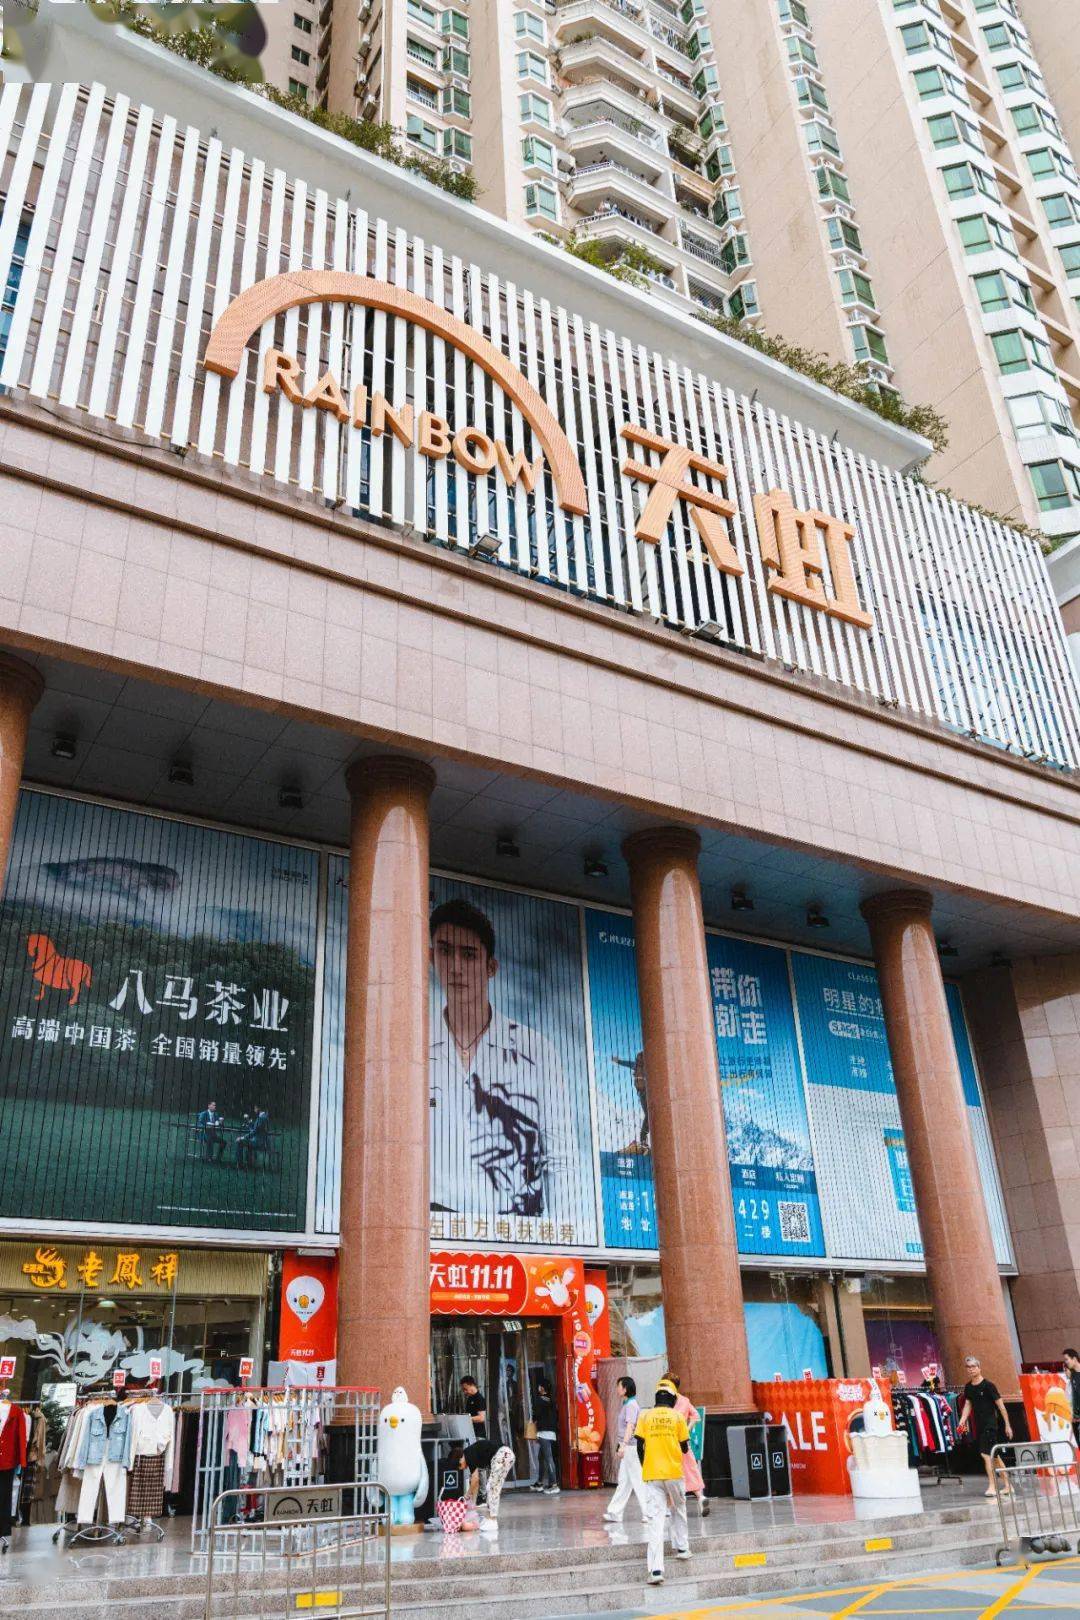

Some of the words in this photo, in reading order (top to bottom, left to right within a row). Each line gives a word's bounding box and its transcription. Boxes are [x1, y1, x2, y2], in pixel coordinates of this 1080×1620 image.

[263, 347, 545, 494] RAINBOW
[620, 421, 873, 628] 天虹
[109, 969, 290, 1032] 八马茶业
[12, 1015, 137, 1051] 高端中国茶
[151, 1033, 288, 1070] 全国销量领先
[738, 1199, 770, 1220] 429
[764, 1411, 829, 1451] ALE
[307, 1498, 333, 1514] 天虹
